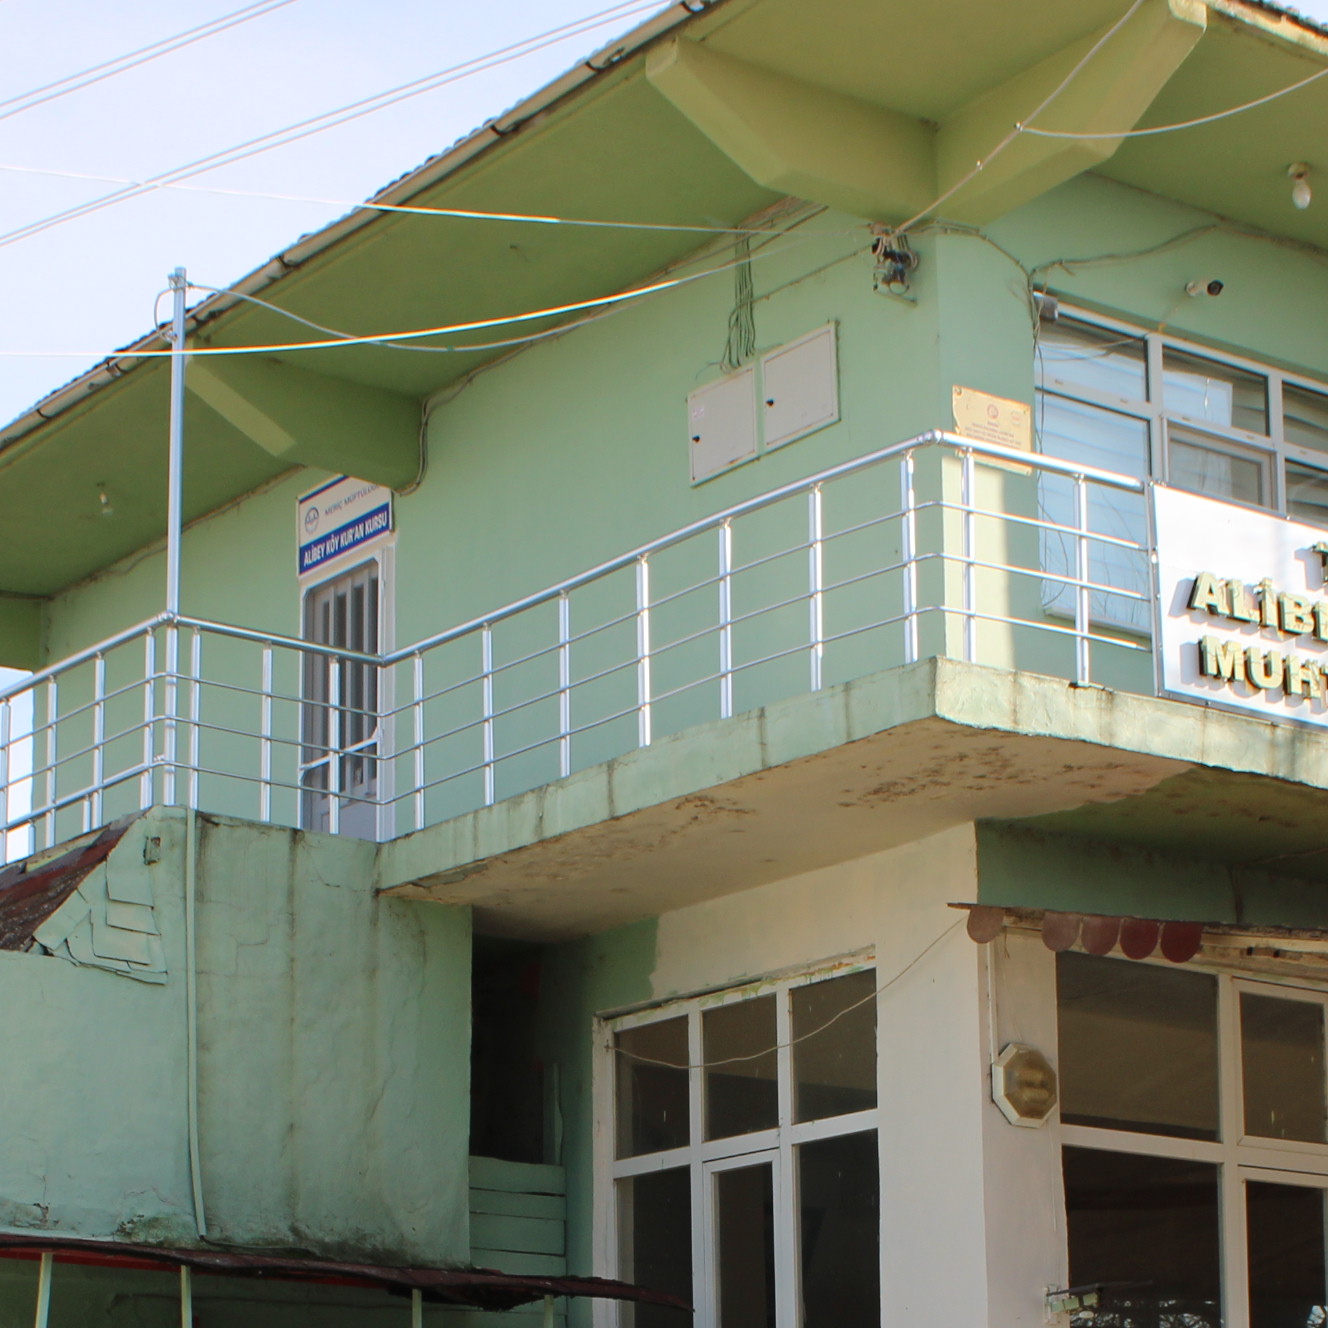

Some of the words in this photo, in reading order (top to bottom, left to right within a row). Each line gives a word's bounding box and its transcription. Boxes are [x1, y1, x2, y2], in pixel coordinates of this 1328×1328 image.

[304, 541, 325, 566] ALİBEY
[326, 534, 340, 556] KÖY
[365, 510, 388, 536] KURSU
